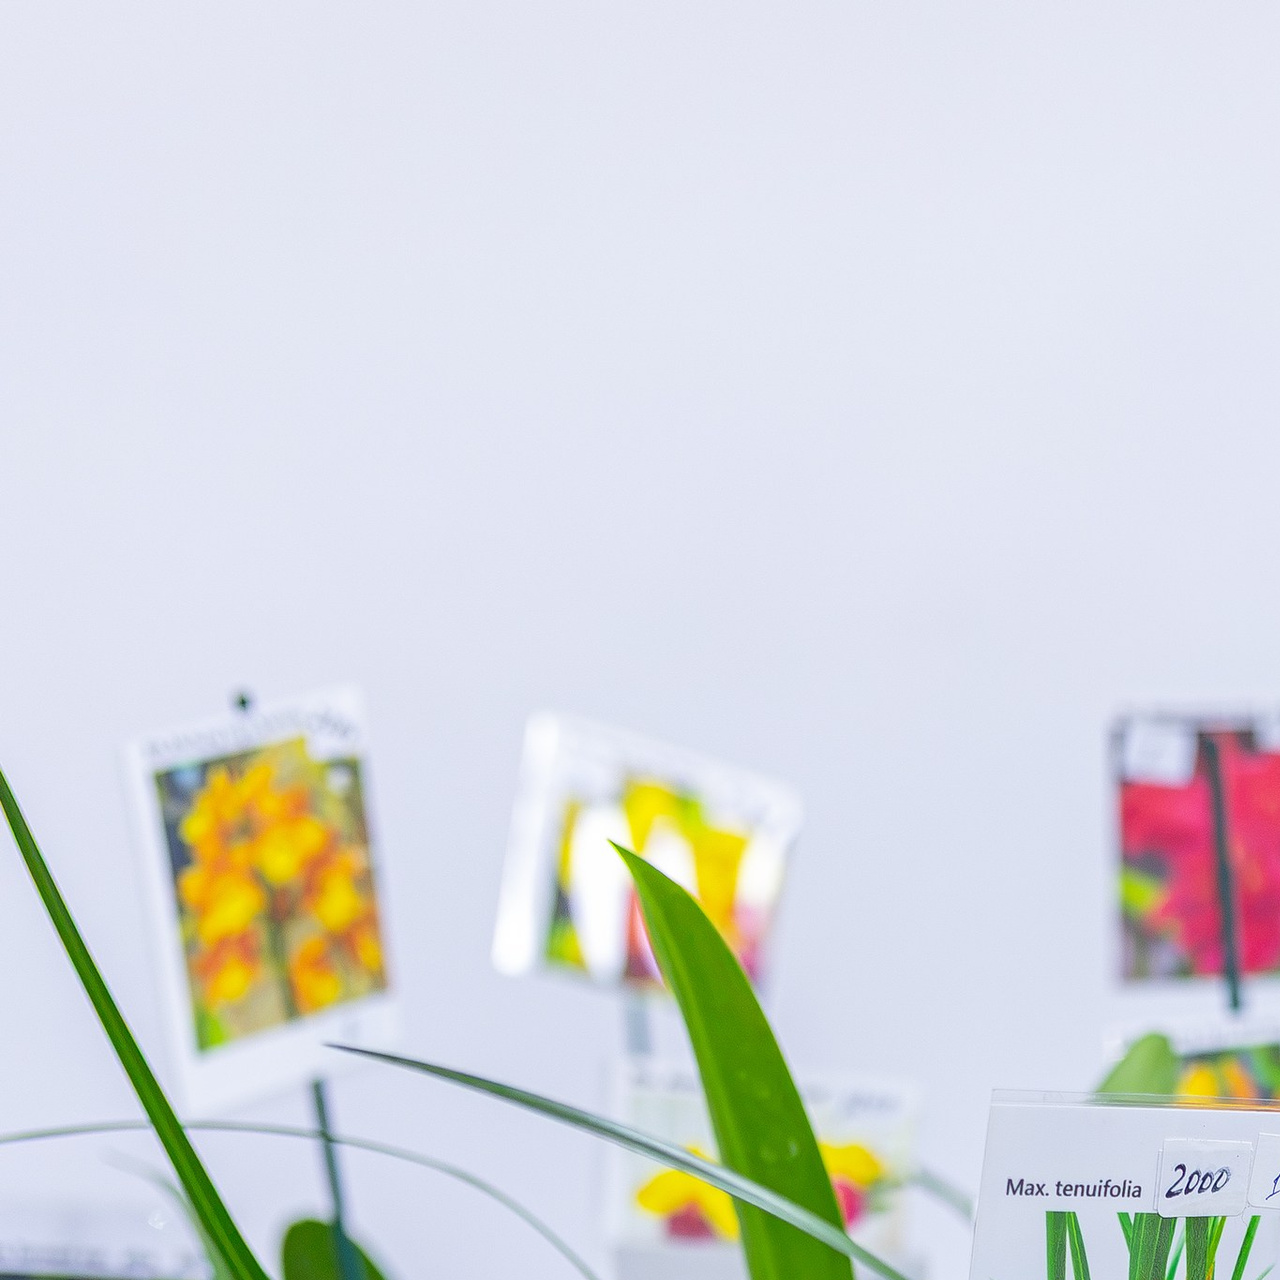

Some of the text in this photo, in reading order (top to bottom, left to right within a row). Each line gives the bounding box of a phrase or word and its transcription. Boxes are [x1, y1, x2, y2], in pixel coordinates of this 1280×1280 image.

[1005, 1178, 1143, 1199] Max. tenuifolia
[1164, 1162, 1232, 1199] 2000
